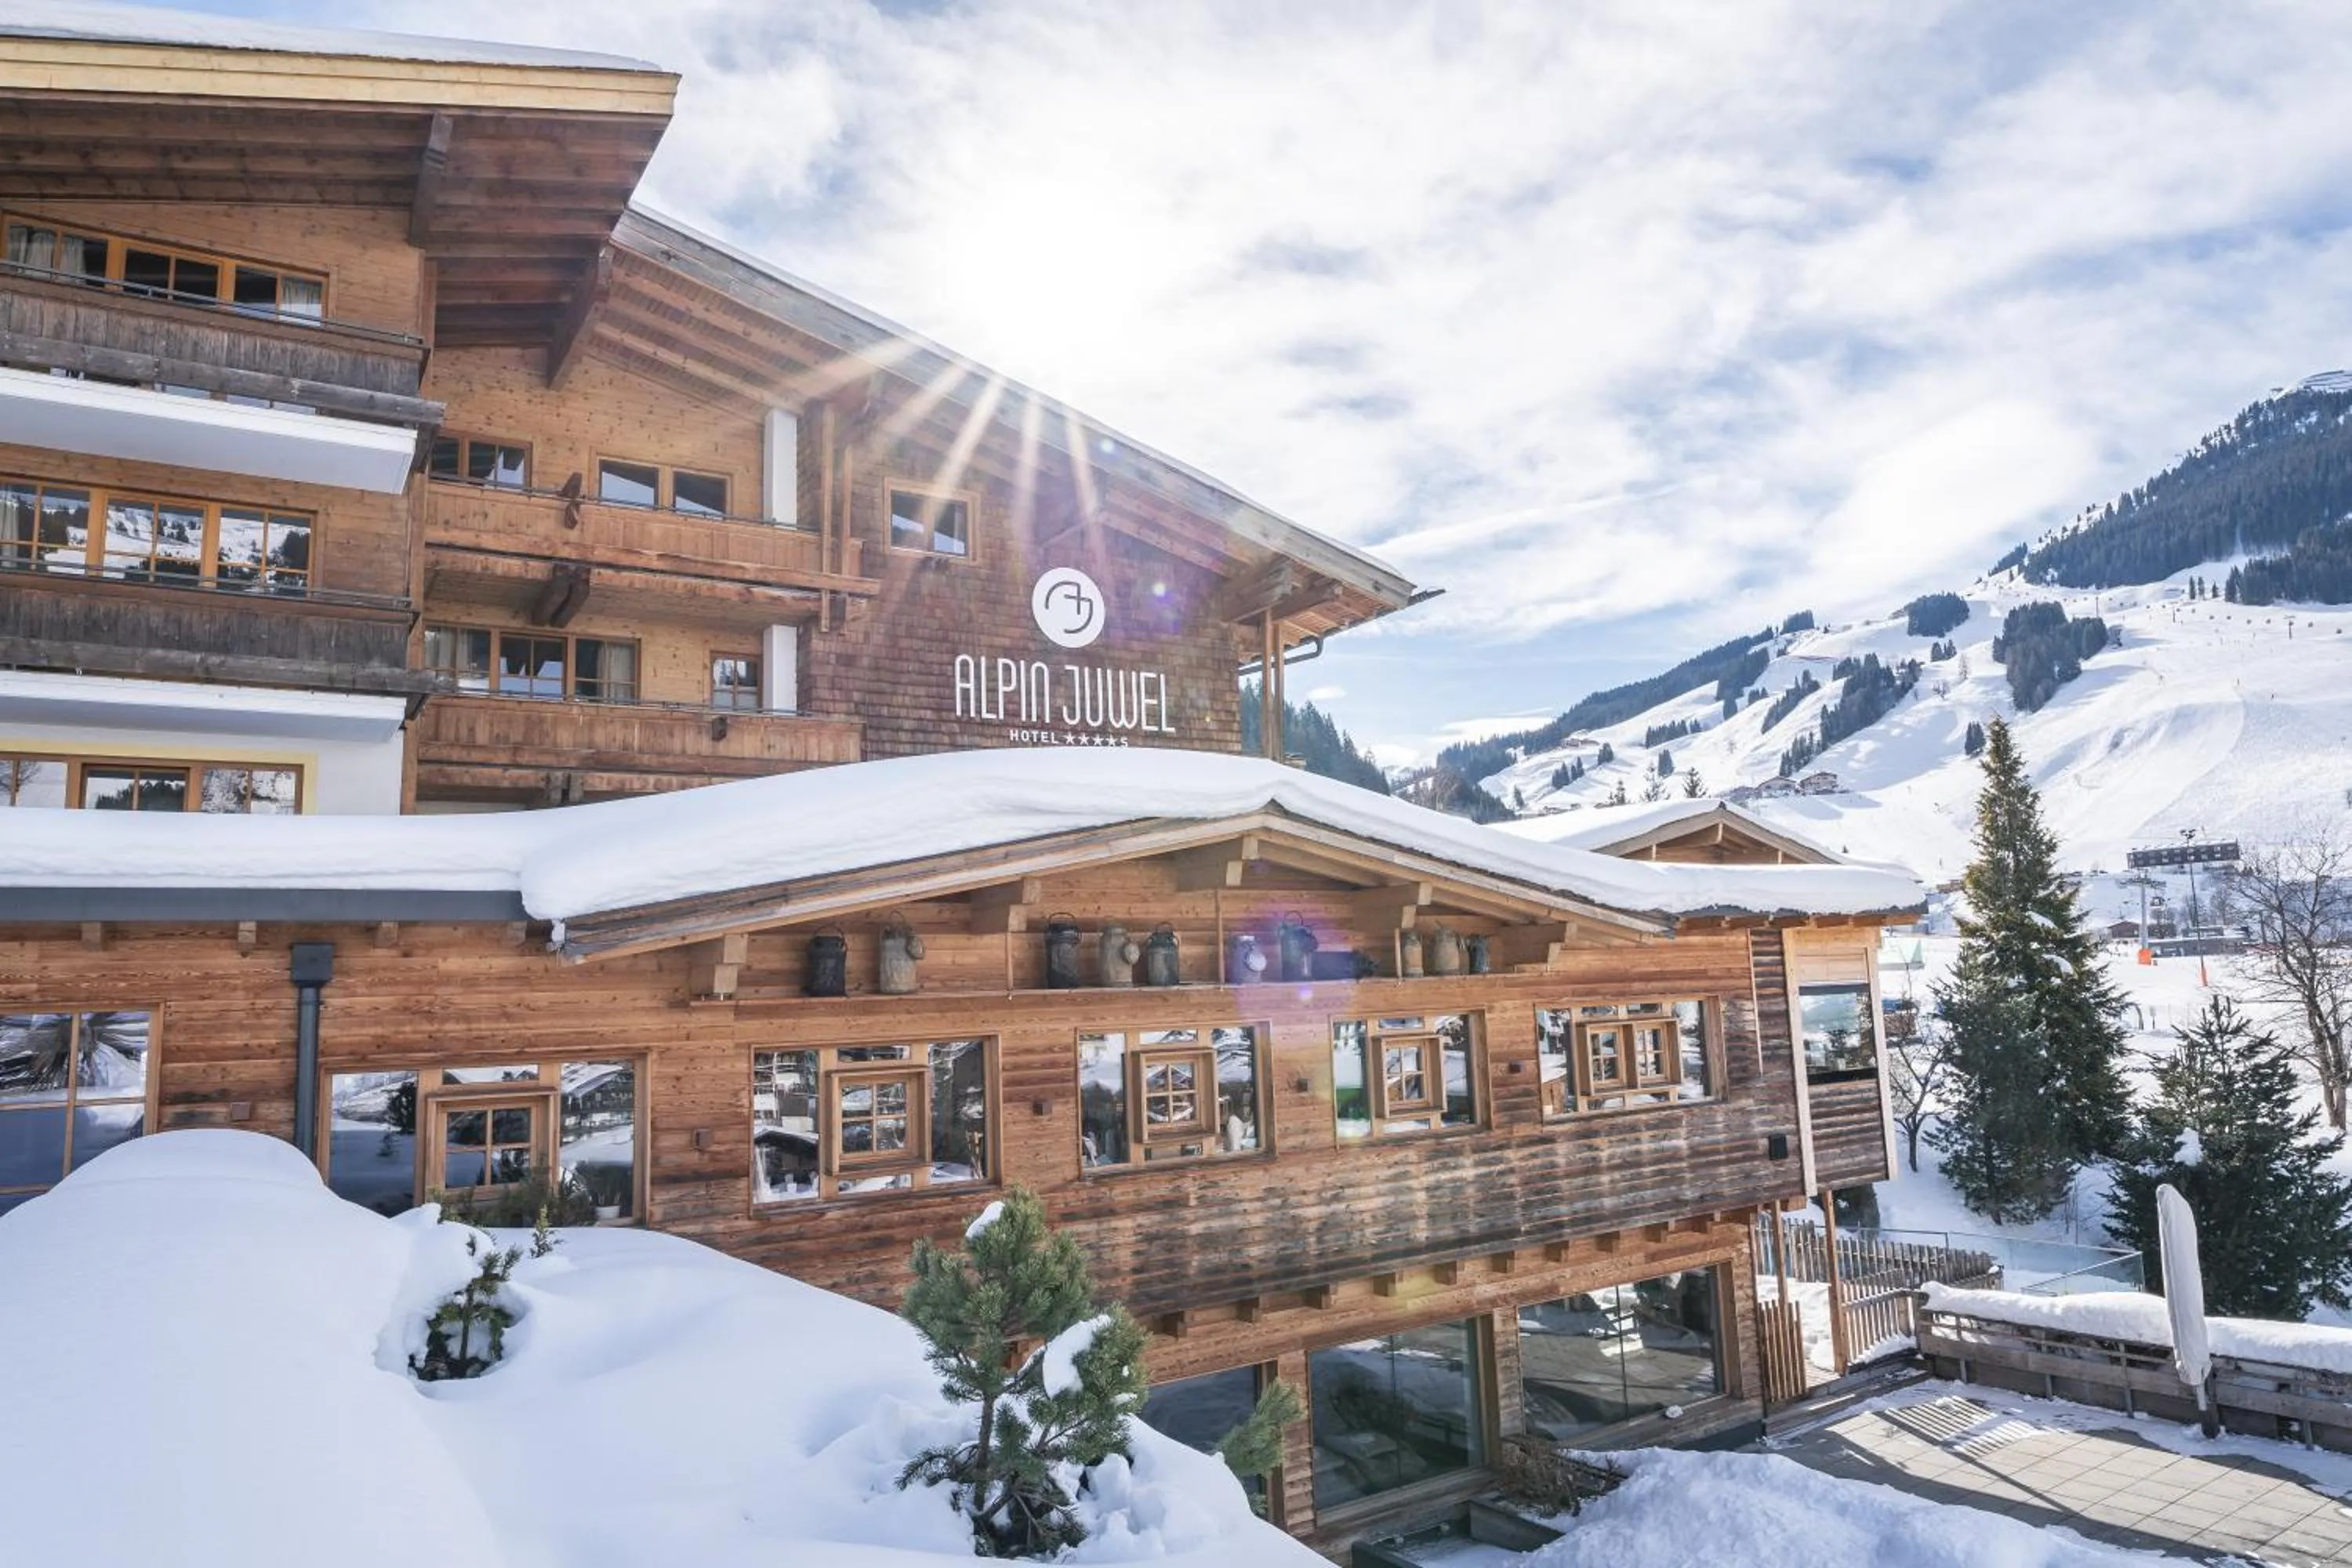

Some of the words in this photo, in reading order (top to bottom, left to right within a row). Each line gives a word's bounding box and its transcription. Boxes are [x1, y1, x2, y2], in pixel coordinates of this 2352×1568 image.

[955, 654, 1051, 723] ALPIN
[1062, 665, 1175, 732] JUWEL
[1010, 730, 1058, 744] HOTEL
